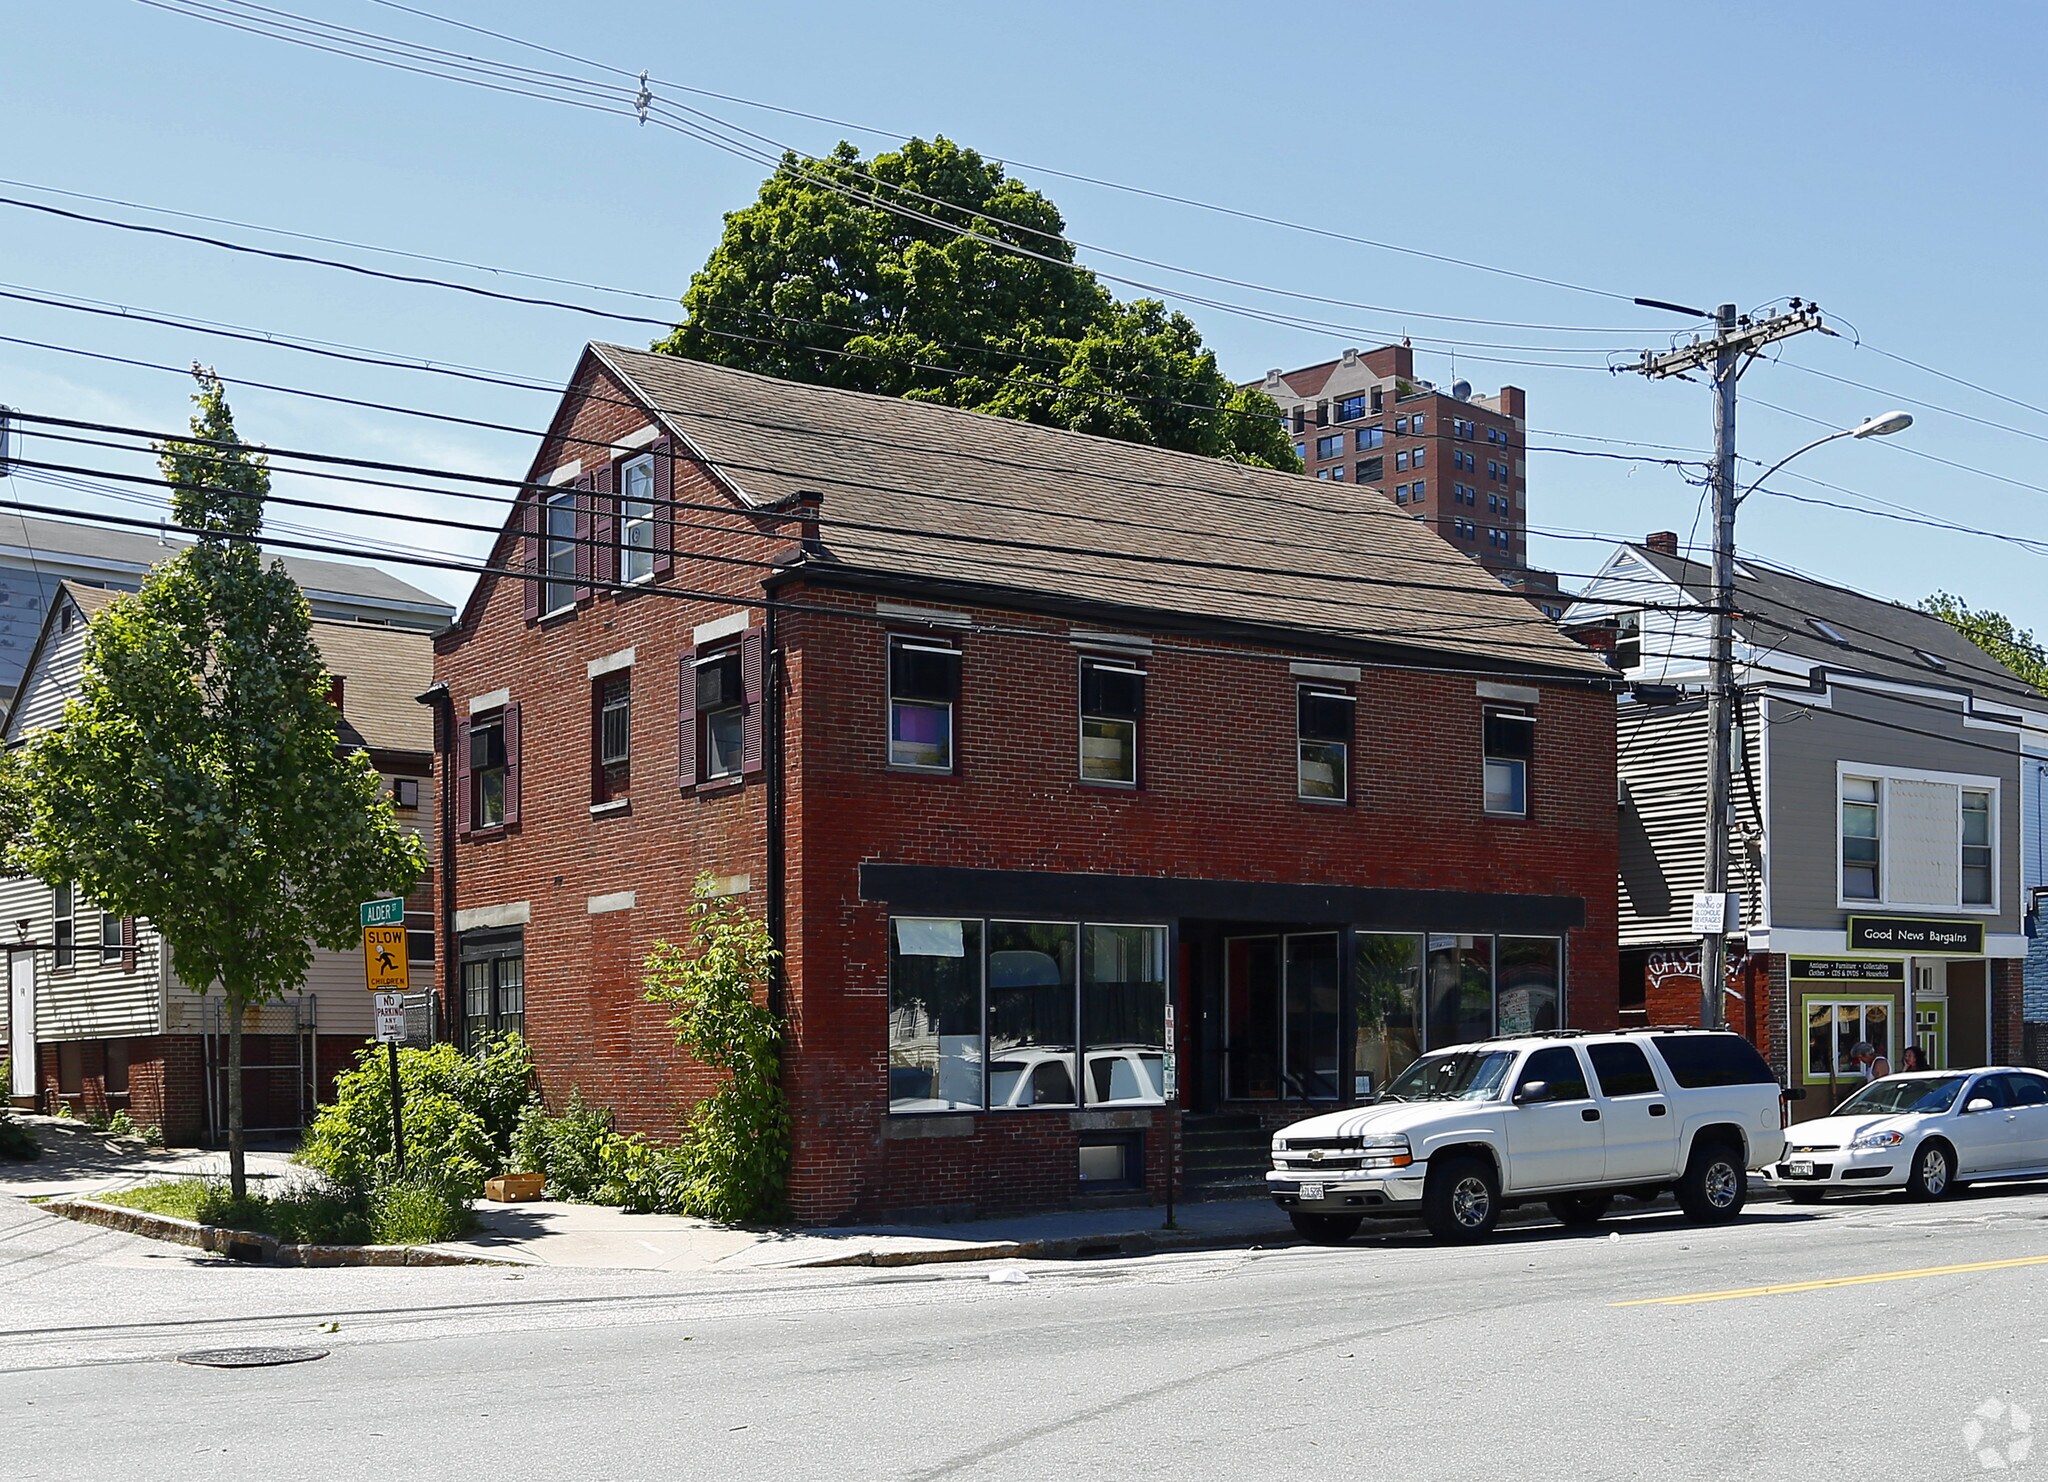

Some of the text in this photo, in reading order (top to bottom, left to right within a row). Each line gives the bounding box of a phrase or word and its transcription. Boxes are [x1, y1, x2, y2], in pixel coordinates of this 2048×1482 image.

[367, 904, 391, 922] ALDER
[368, 931, 402, 943] SLOW
[1864, 928, 1967, 945] Good News Bargains
[1809, 962, 1829, 970] Antiques
[383, 996, 394, 1006] NO
[377, 1007, 403, 1017] PARKING
